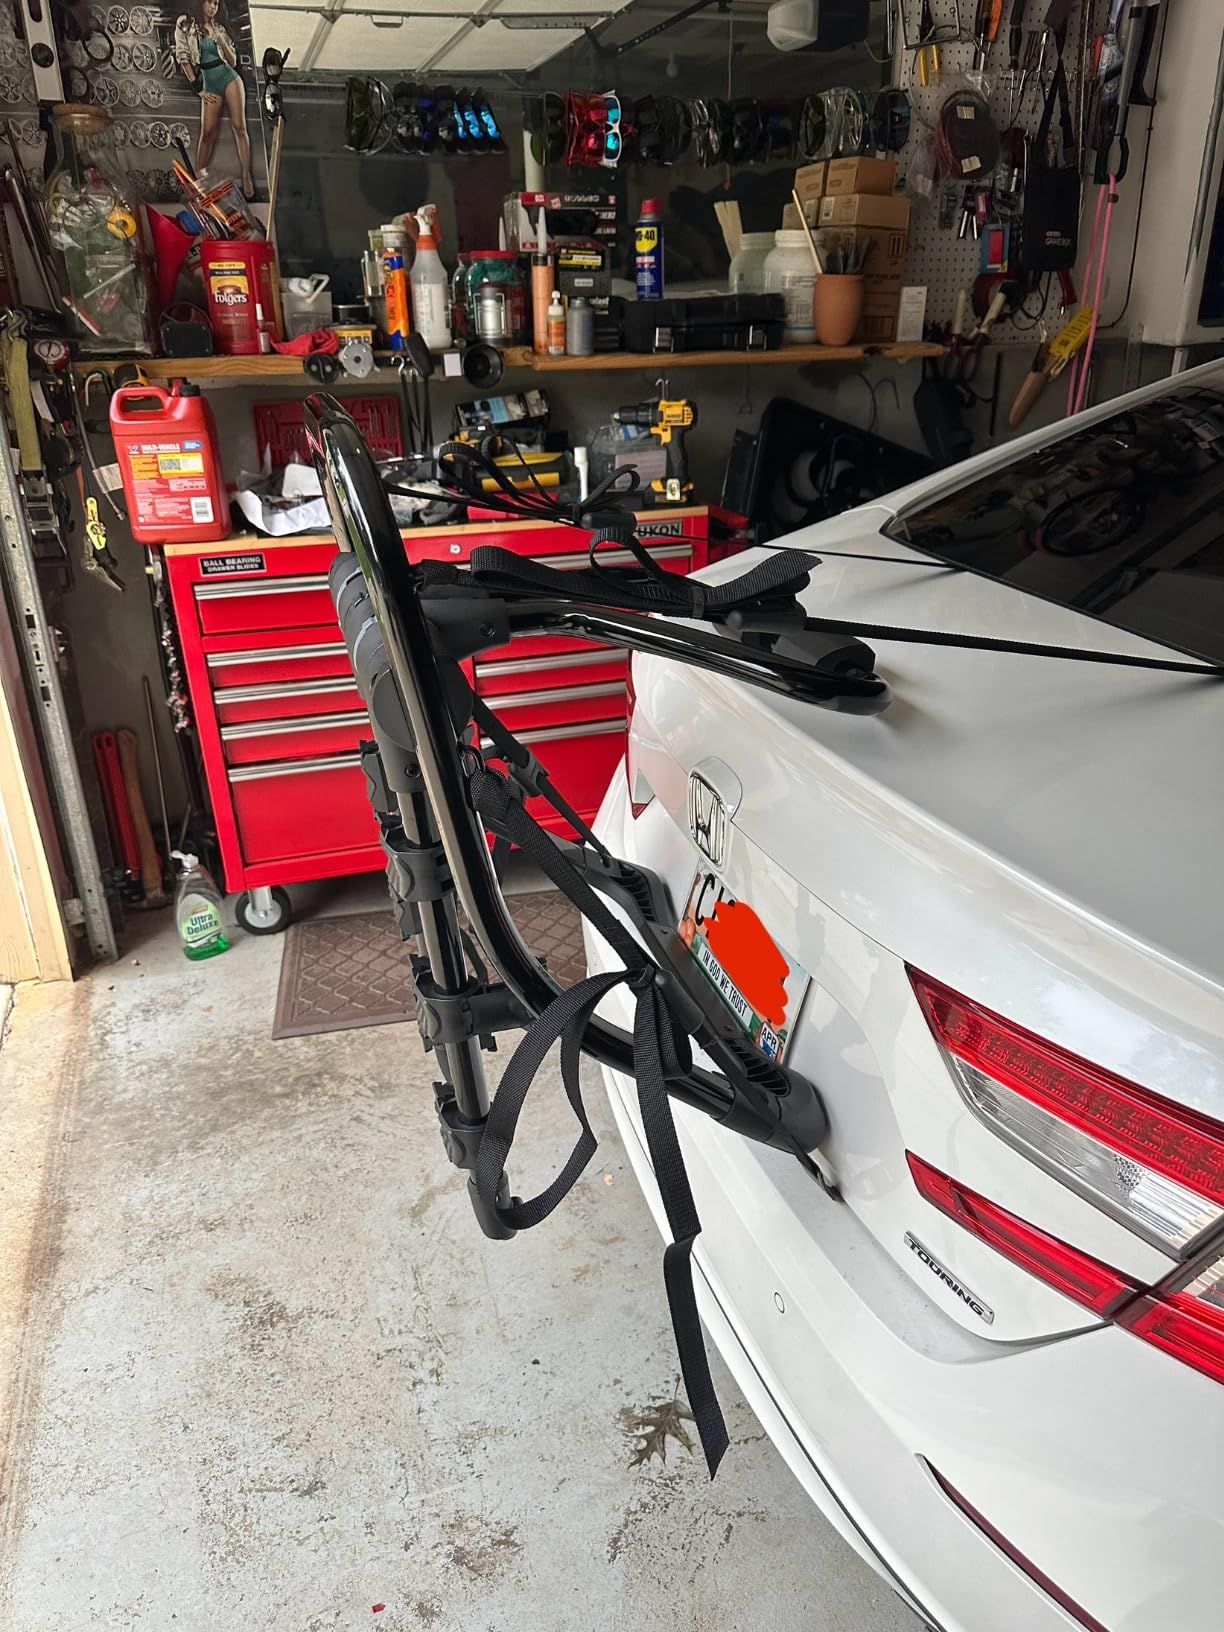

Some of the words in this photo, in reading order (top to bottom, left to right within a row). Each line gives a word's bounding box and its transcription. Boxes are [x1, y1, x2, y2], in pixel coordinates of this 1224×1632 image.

[214, 291, 248, 306] Folgers
[638, 524, 680, 536] UKON
[203, 559, 225, 568] BALL
[225, 556, 261, 566] BEARING
[187, 920, 219, 935] Deluxe
[190, 914, 213, 926] Ultra
[702, 949, 712, 967] IN
[709, 959, 721, 981] GOD
[719, 973, 730, 994] WE
[728, 986, 748, 1017] TRUST
[761, 1027, 777, 1051] APR
[908, 1238, 985, 1316] TOURING
